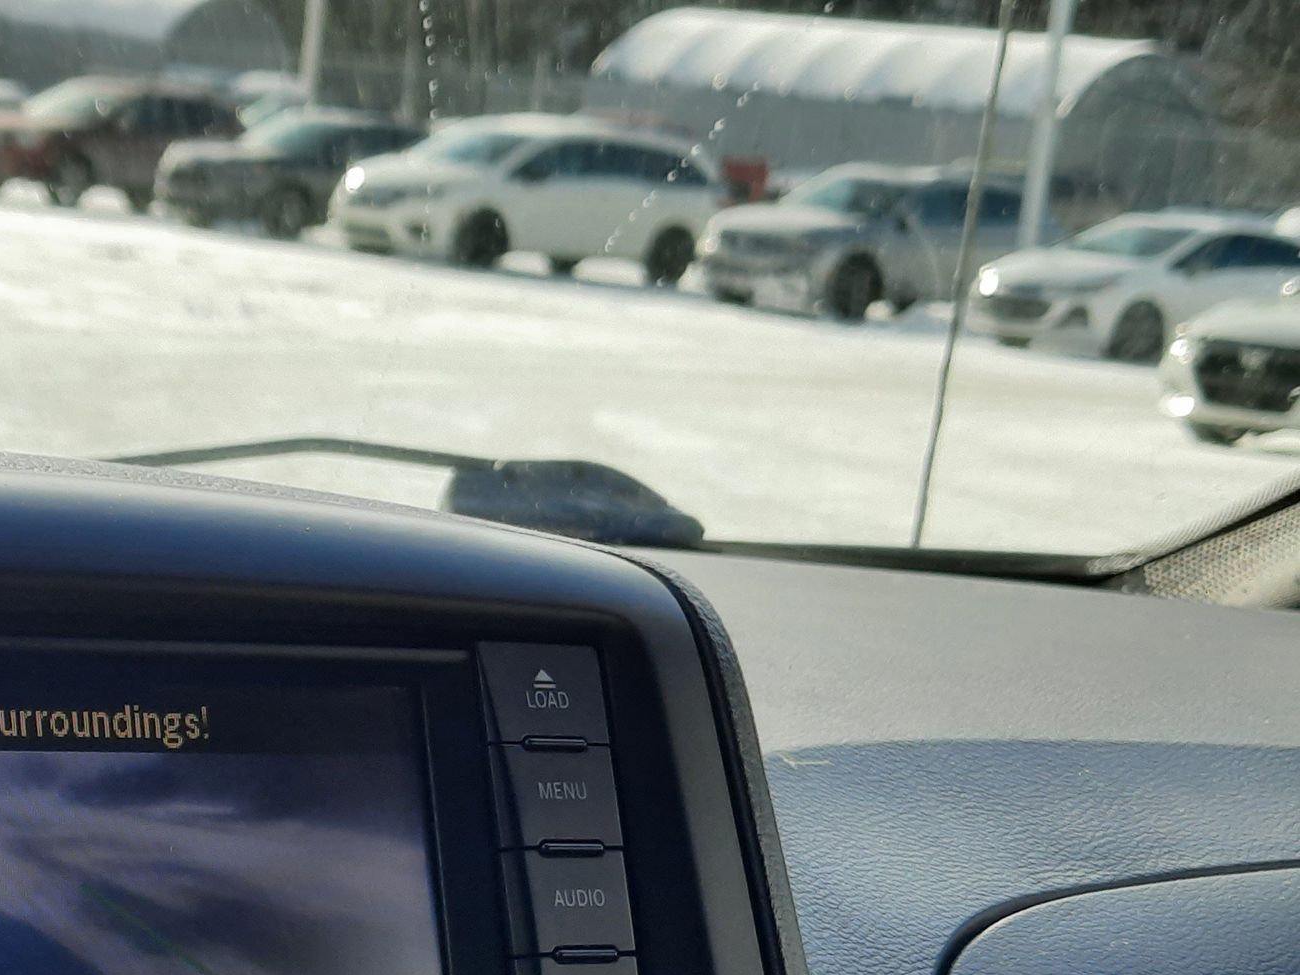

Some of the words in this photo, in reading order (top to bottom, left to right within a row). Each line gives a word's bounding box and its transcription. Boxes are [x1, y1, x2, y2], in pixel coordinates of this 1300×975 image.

[525, 690, 569, 710] LOAD
[538, 781, 588, 801] MENU
[554, 888, 606, 908] AUDIO
